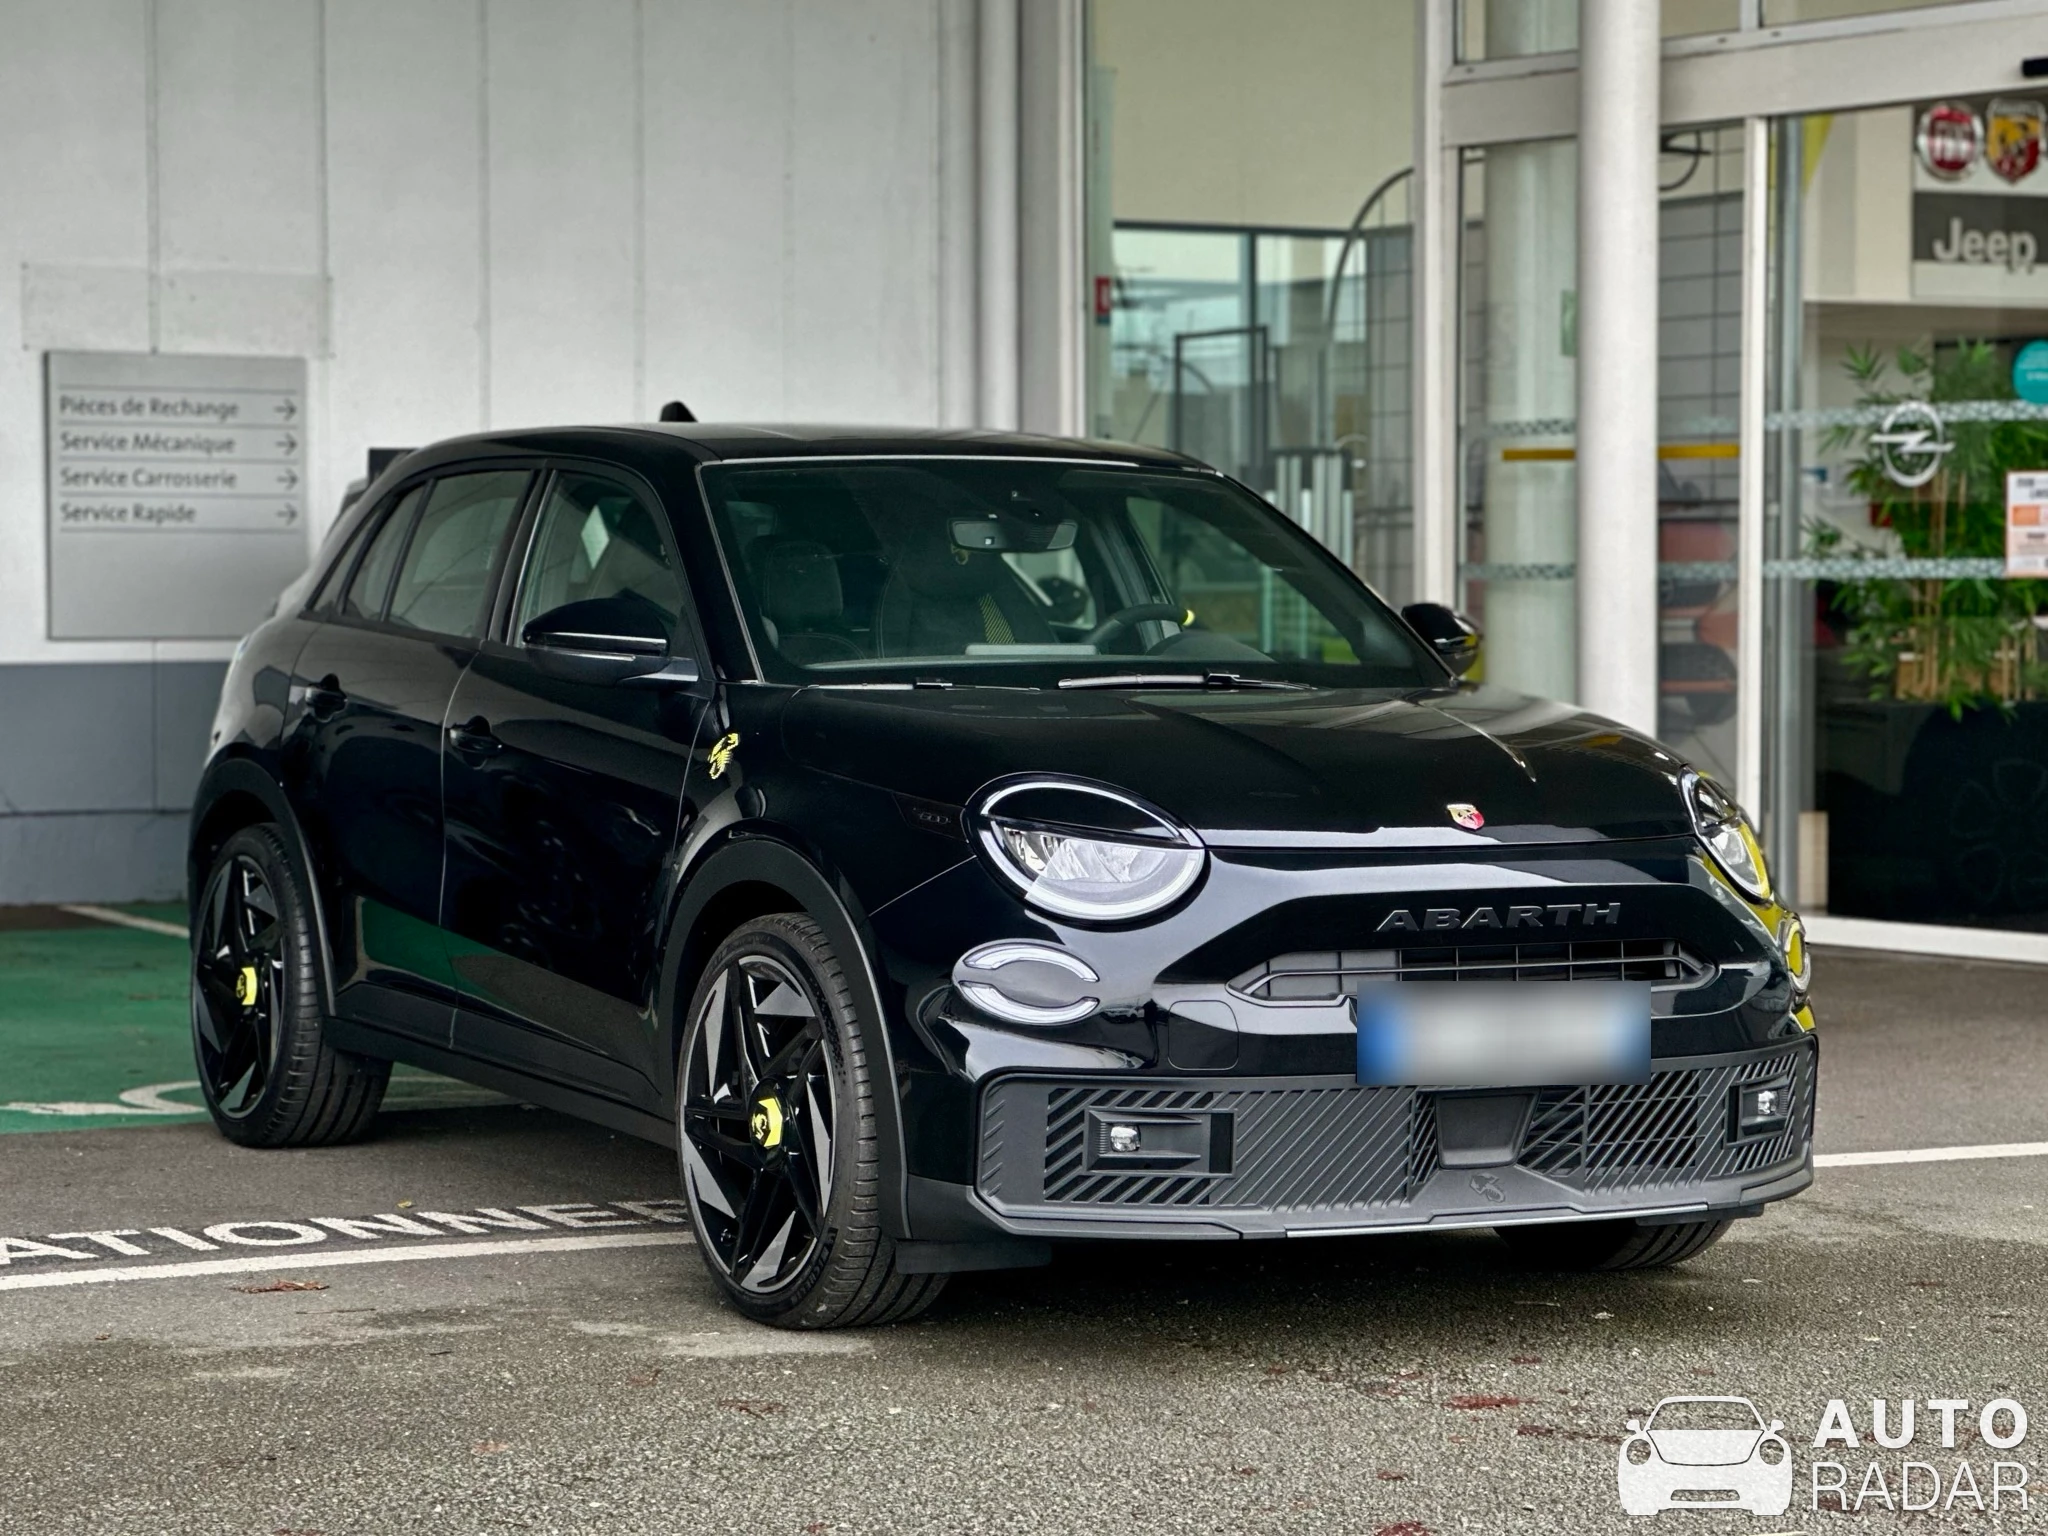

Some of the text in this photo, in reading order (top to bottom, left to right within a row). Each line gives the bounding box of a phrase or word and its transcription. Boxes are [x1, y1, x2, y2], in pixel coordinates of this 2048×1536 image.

[1932, 217, 2037, 275] Jeep
[59, 395, 240, 423] Pièces de Rechange
[59, 431, 237, 457] Service Mécanique
[59, 466, 237, 488] Service Carrosserie
[59, 502, 197, 527] Service Rapide
[1376, 902, 1621, 932] ABARTH
